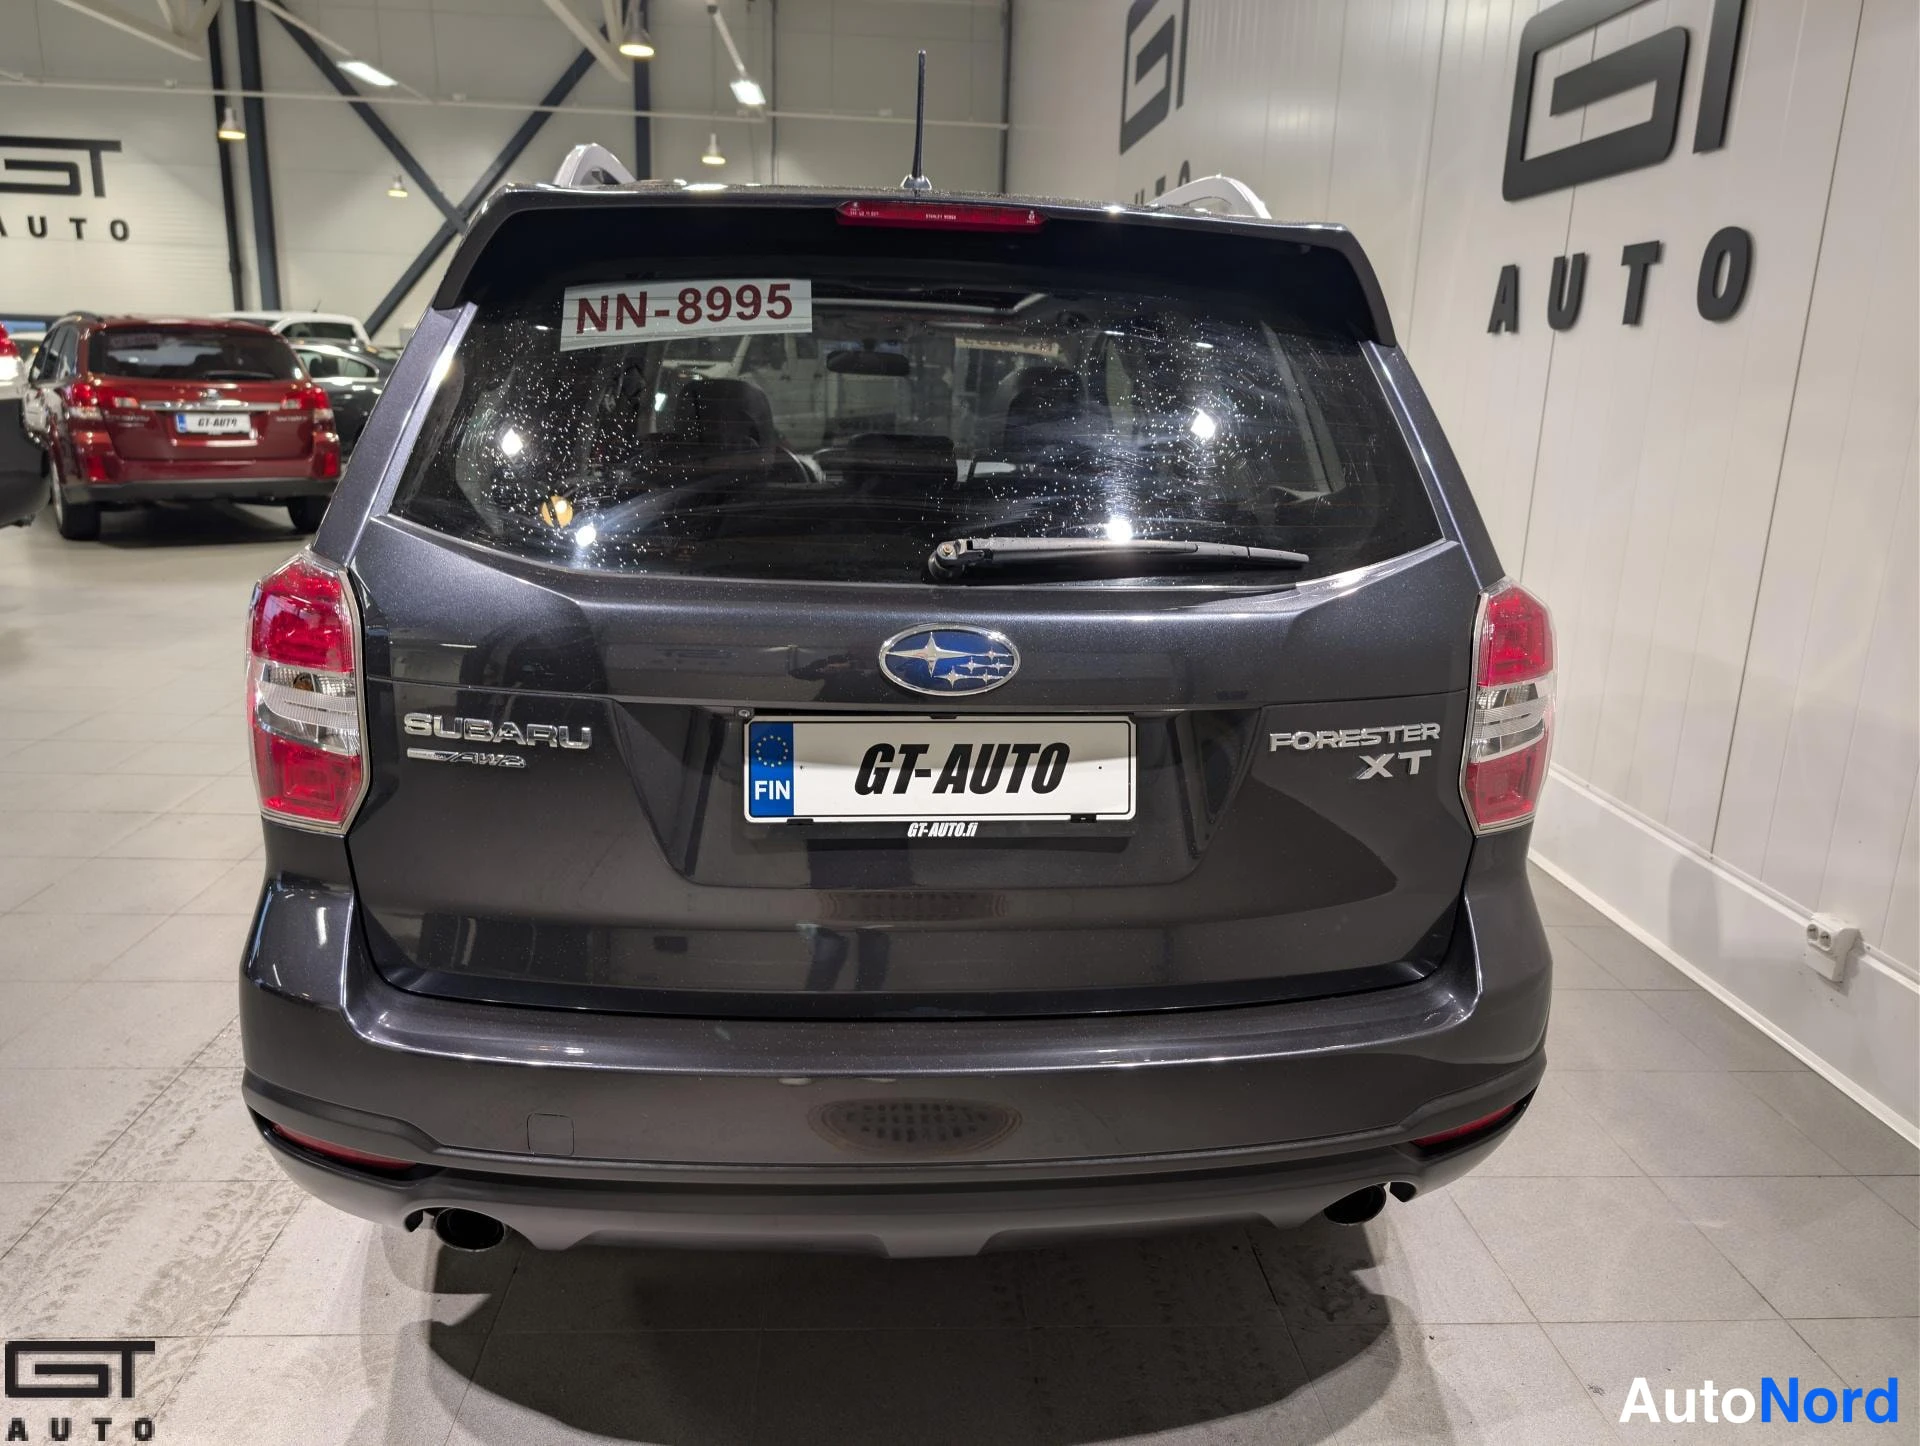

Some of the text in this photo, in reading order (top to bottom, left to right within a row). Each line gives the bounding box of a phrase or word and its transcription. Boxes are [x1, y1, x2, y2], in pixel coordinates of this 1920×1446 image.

[1487, 226, 1753, 334] AUTO
[576, 283, 793, 334] NN-8995
[403, 712, 592, 750] SUBARU
[1269, 722, 1441, 751] FORESTER
[854, 742, 1071, 796] GT-AUTO
[1356, 749, 1432, 780] XT
[754, 780, 791, 801] FIN
[907, 822, 978, 838] GT-AUTO.fi
